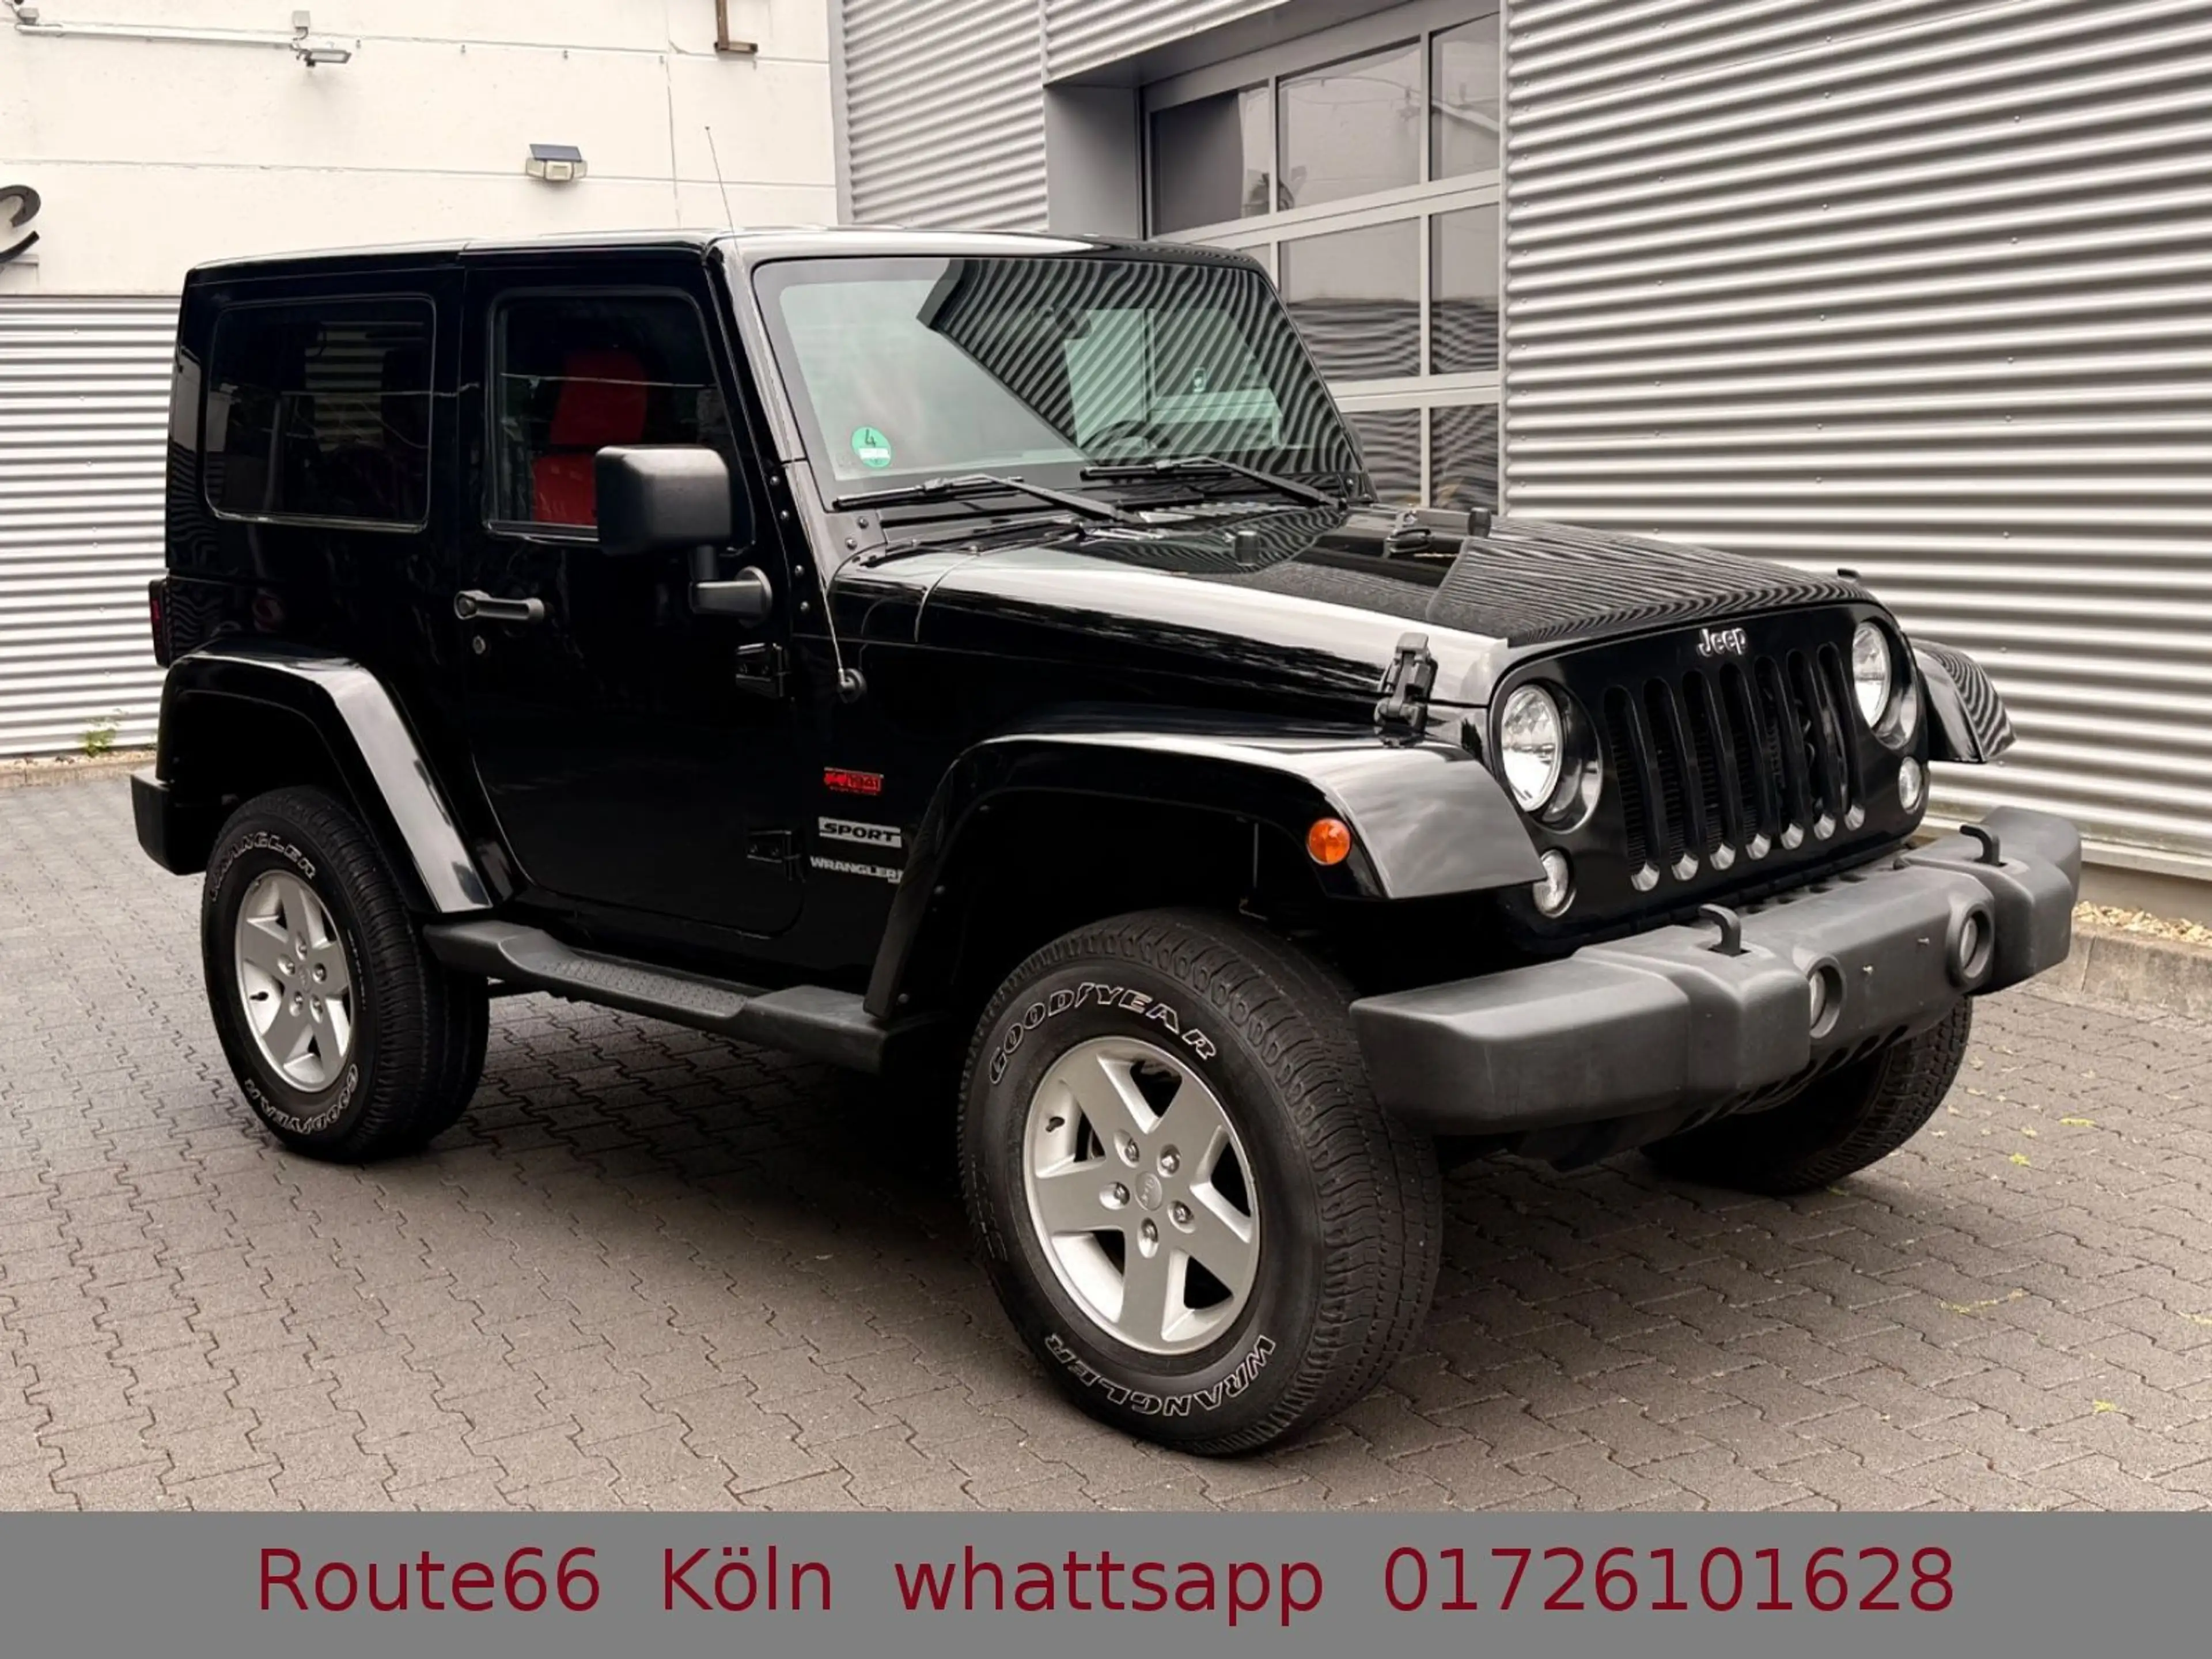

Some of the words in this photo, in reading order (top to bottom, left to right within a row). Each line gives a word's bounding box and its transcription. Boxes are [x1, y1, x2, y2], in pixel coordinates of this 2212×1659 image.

[1696, 627, 1747, 657] Jeep
[820, 822, 900, 842] SPORT
[810, 855, 897, 880] WRANGLER
[989, 982, 1217, 1085] GOODYEAR
[1044, 1332, 1277, 1416] WRANGLER
